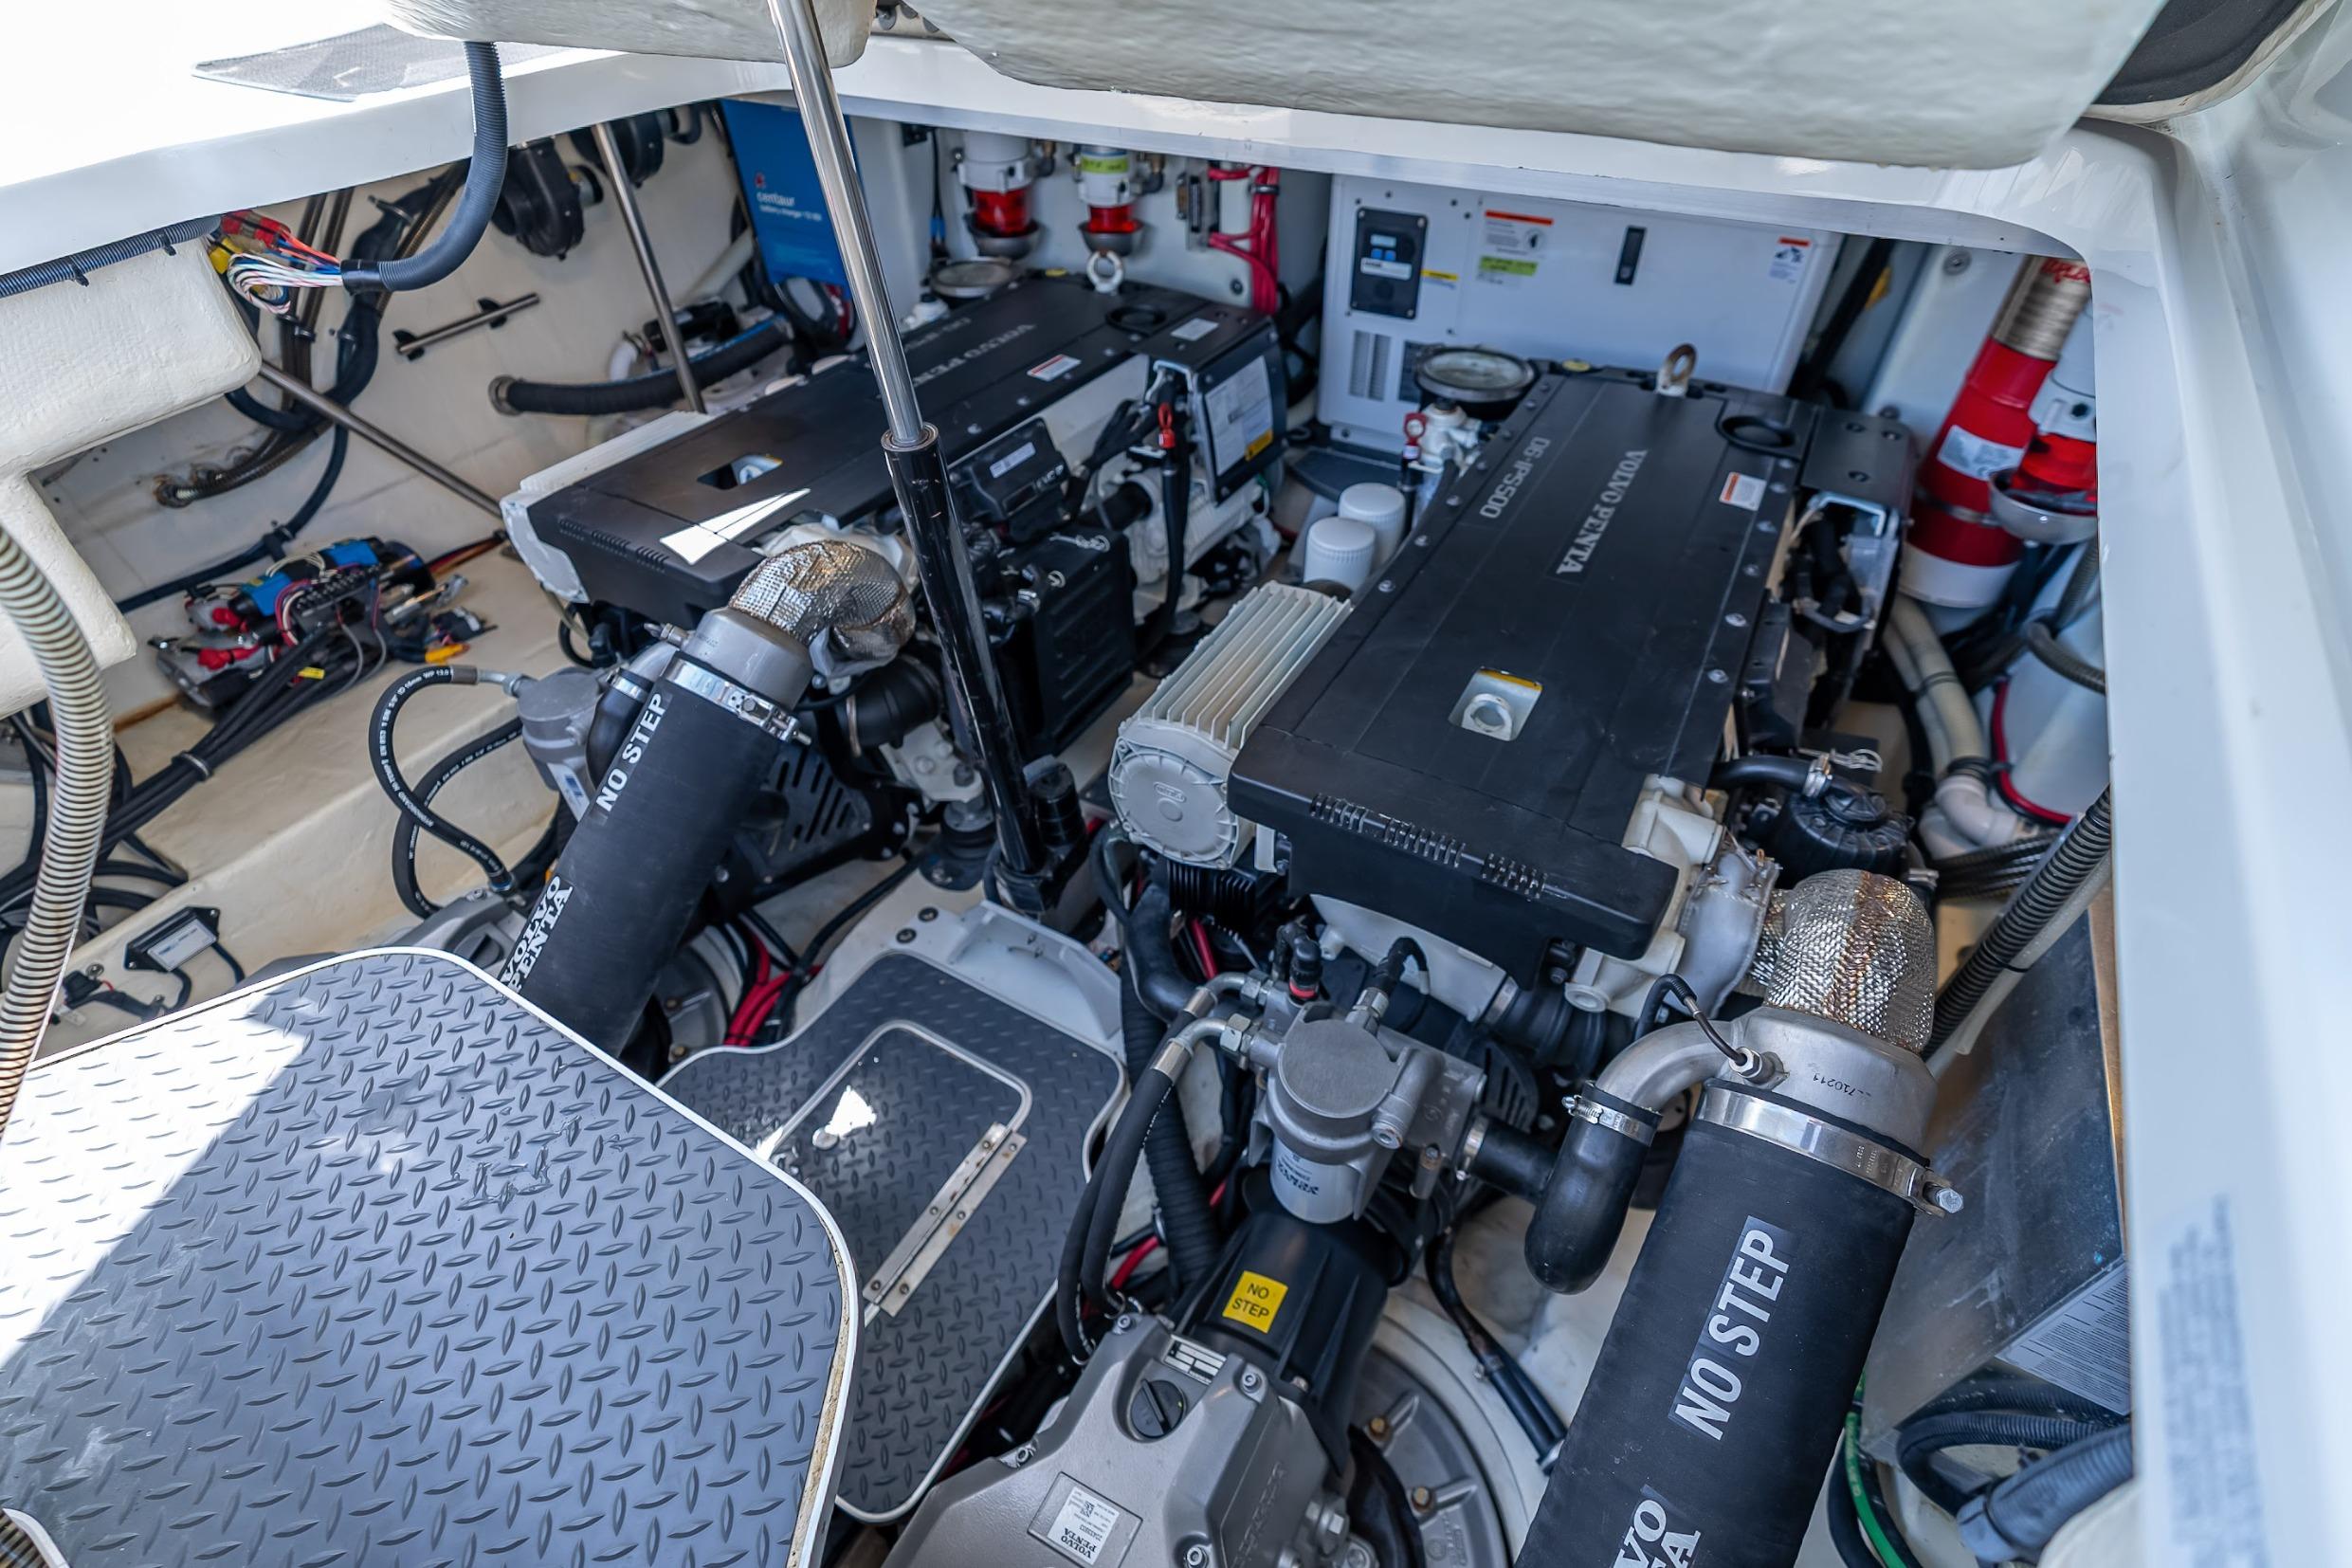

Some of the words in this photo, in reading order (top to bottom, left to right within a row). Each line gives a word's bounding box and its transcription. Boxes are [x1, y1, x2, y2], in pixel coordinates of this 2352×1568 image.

[1599, 449, 1649, 504] VOLVO
[1556, 503, 1615, 574] PENTA
[596, 768, 628, 811] NO
[622, 693, 665, 764] STEP
[500, 876, 560, 985] VOLVO
[508, 886, 573, 994] PENTA
[1232, 1297, 1269, 1319] STEP
[1247, 1283, 1269, 1300] NO
[1674, 1358, 1742, 1441] NO
[1708, 1230, 1790, 1357] STEP
[1061, 1535, 1092, 1559] VOLVO
[1064, 1527, 1097, 1553] PENTA
